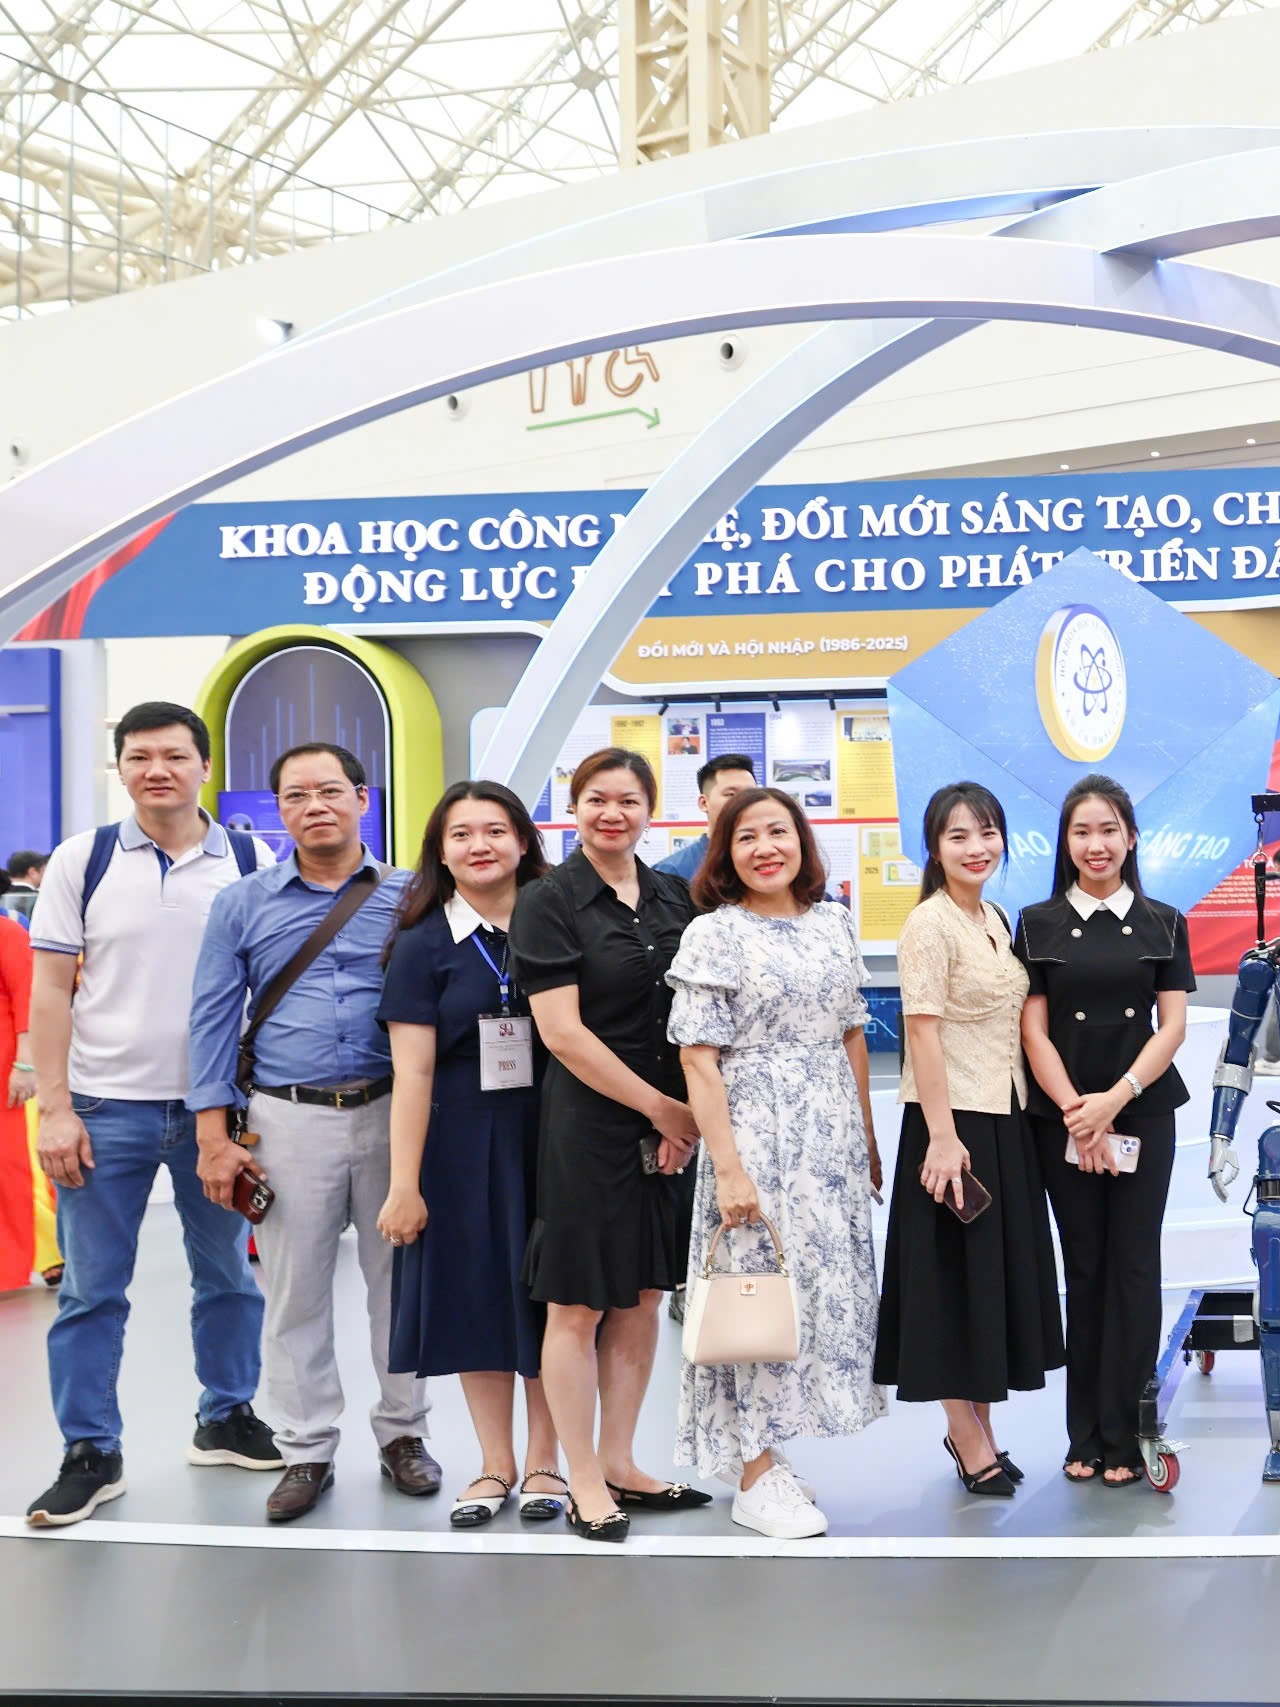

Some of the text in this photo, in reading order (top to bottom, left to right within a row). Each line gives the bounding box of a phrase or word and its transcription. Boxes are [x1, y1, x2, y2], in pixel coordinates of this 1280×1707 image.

[219, 522, 352, 558] KHOA
[358, 518, 460, 561] HỌC
[468, 508, 601, 551] CÔNG
[761, 496, 848, 540] ĐỔI
[858, 494, 950, 538] MỚI
[960, 491, 1085, 534] SÁNG
[1096, 494, 1202, 538] TẠO,
[303, 563, 448, 613] ĐỘNG
[459, 560, 557, 609] LỰC
[694, 552, 800, 595] PHÁ
[814, 558, 926, 593] CHO
[638, 635, 908, 659] ĐỔI MỚI VÀ HỘI NHẬP (1986-2025)
